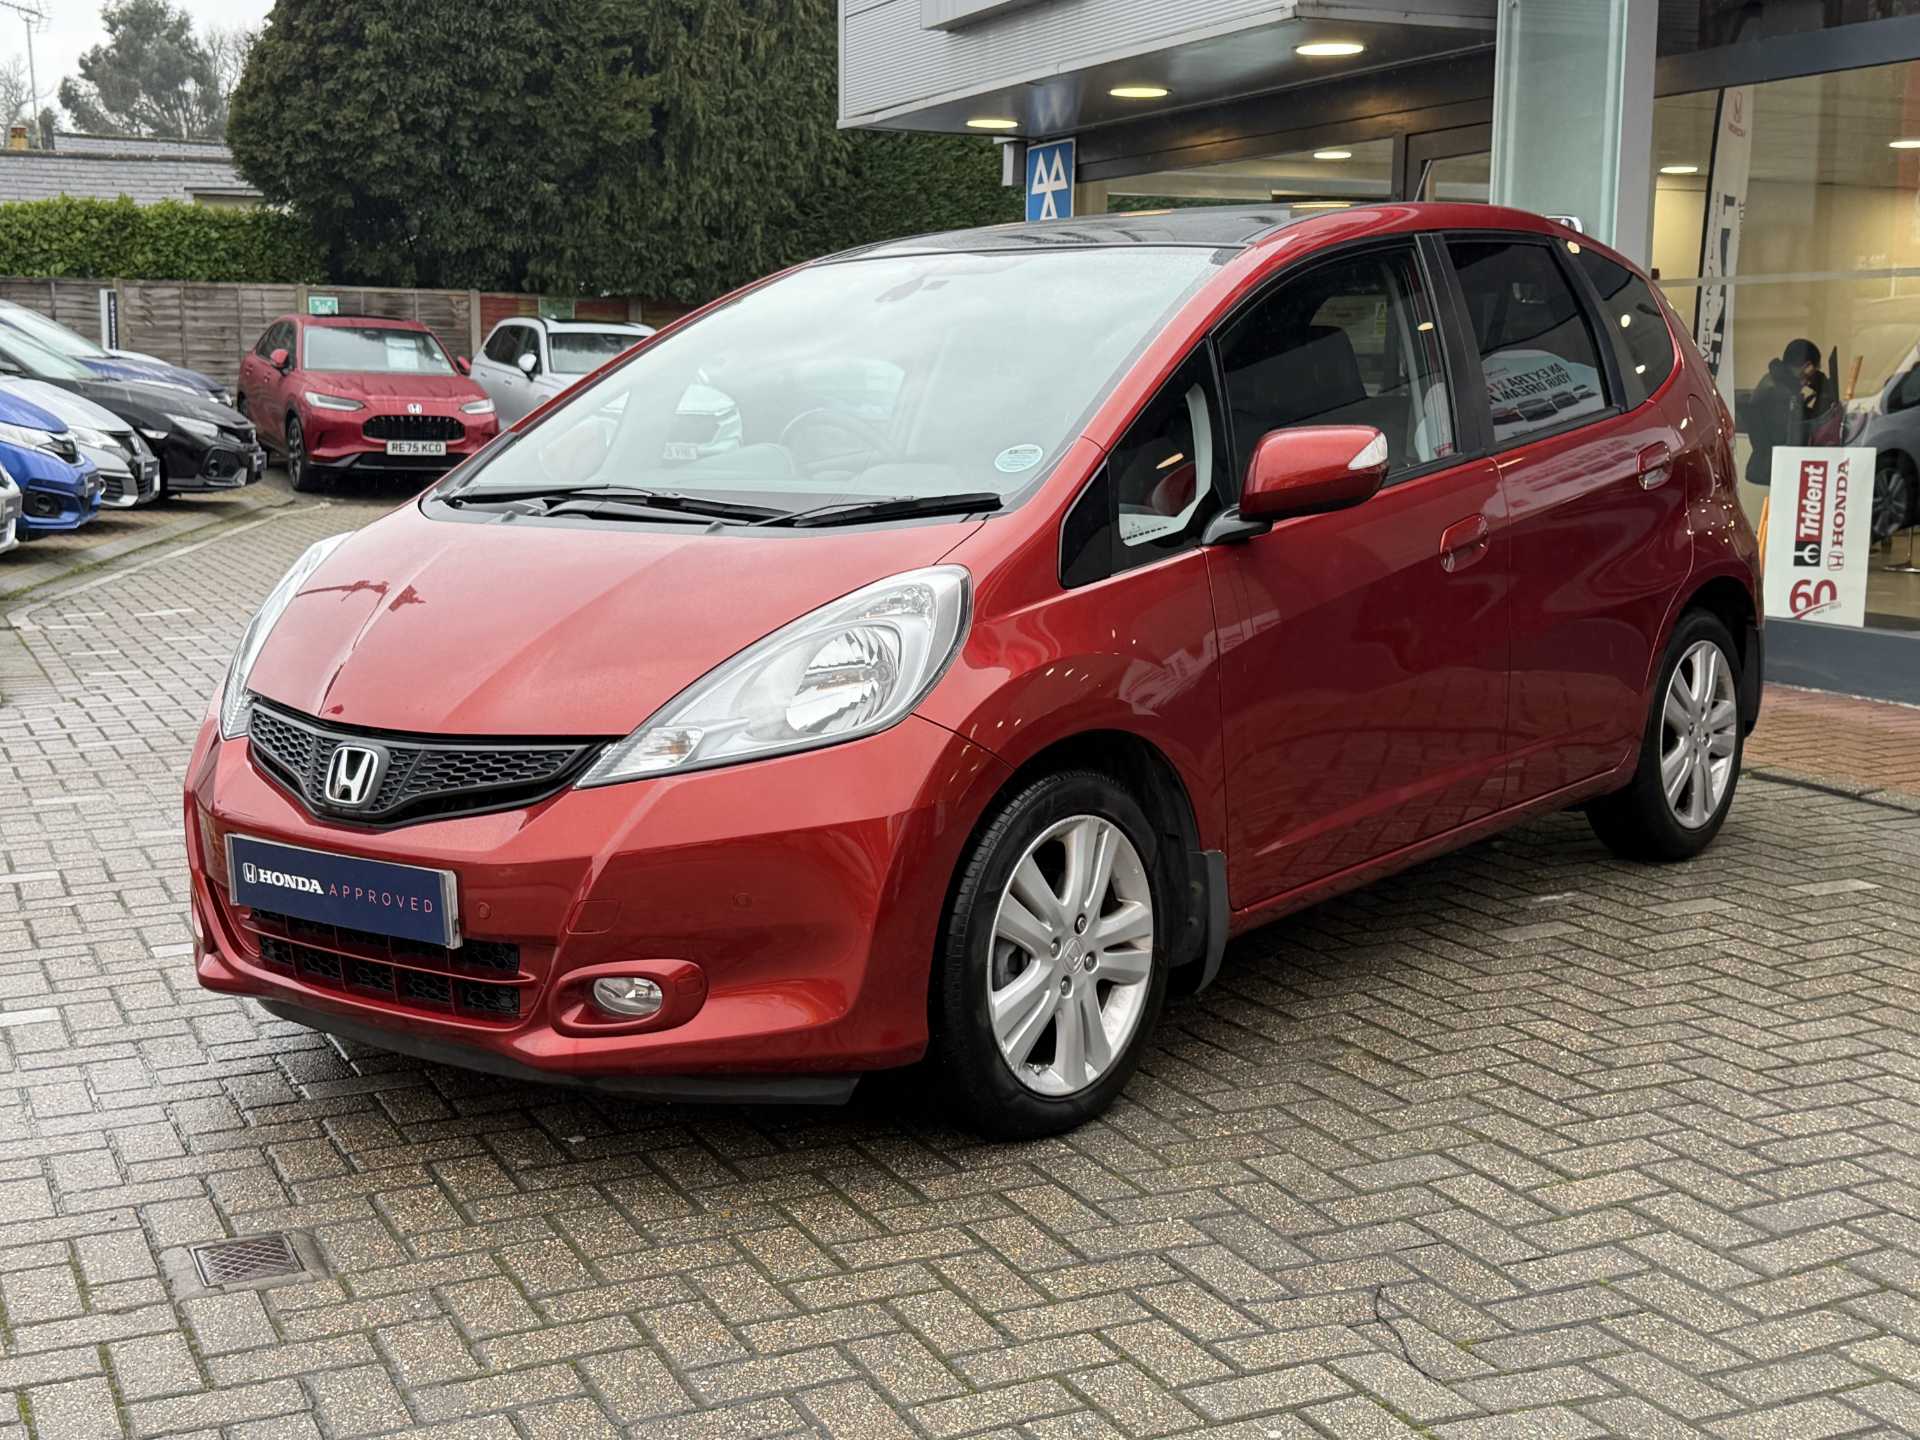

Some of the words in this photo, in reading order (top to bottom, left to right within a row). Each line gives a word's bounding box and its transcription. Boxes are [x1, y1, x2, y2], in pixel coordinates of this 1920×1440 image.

[391, 442, 419, 453] RE75
[1800, 465, 1825, 538] Trident
[1832, 458, 1850, 548] HONDA
[1789, 579, 1838, 614] 60
[257, 868, 324, 895] HONDA
[329, 883, 433, 913] APPROVED
